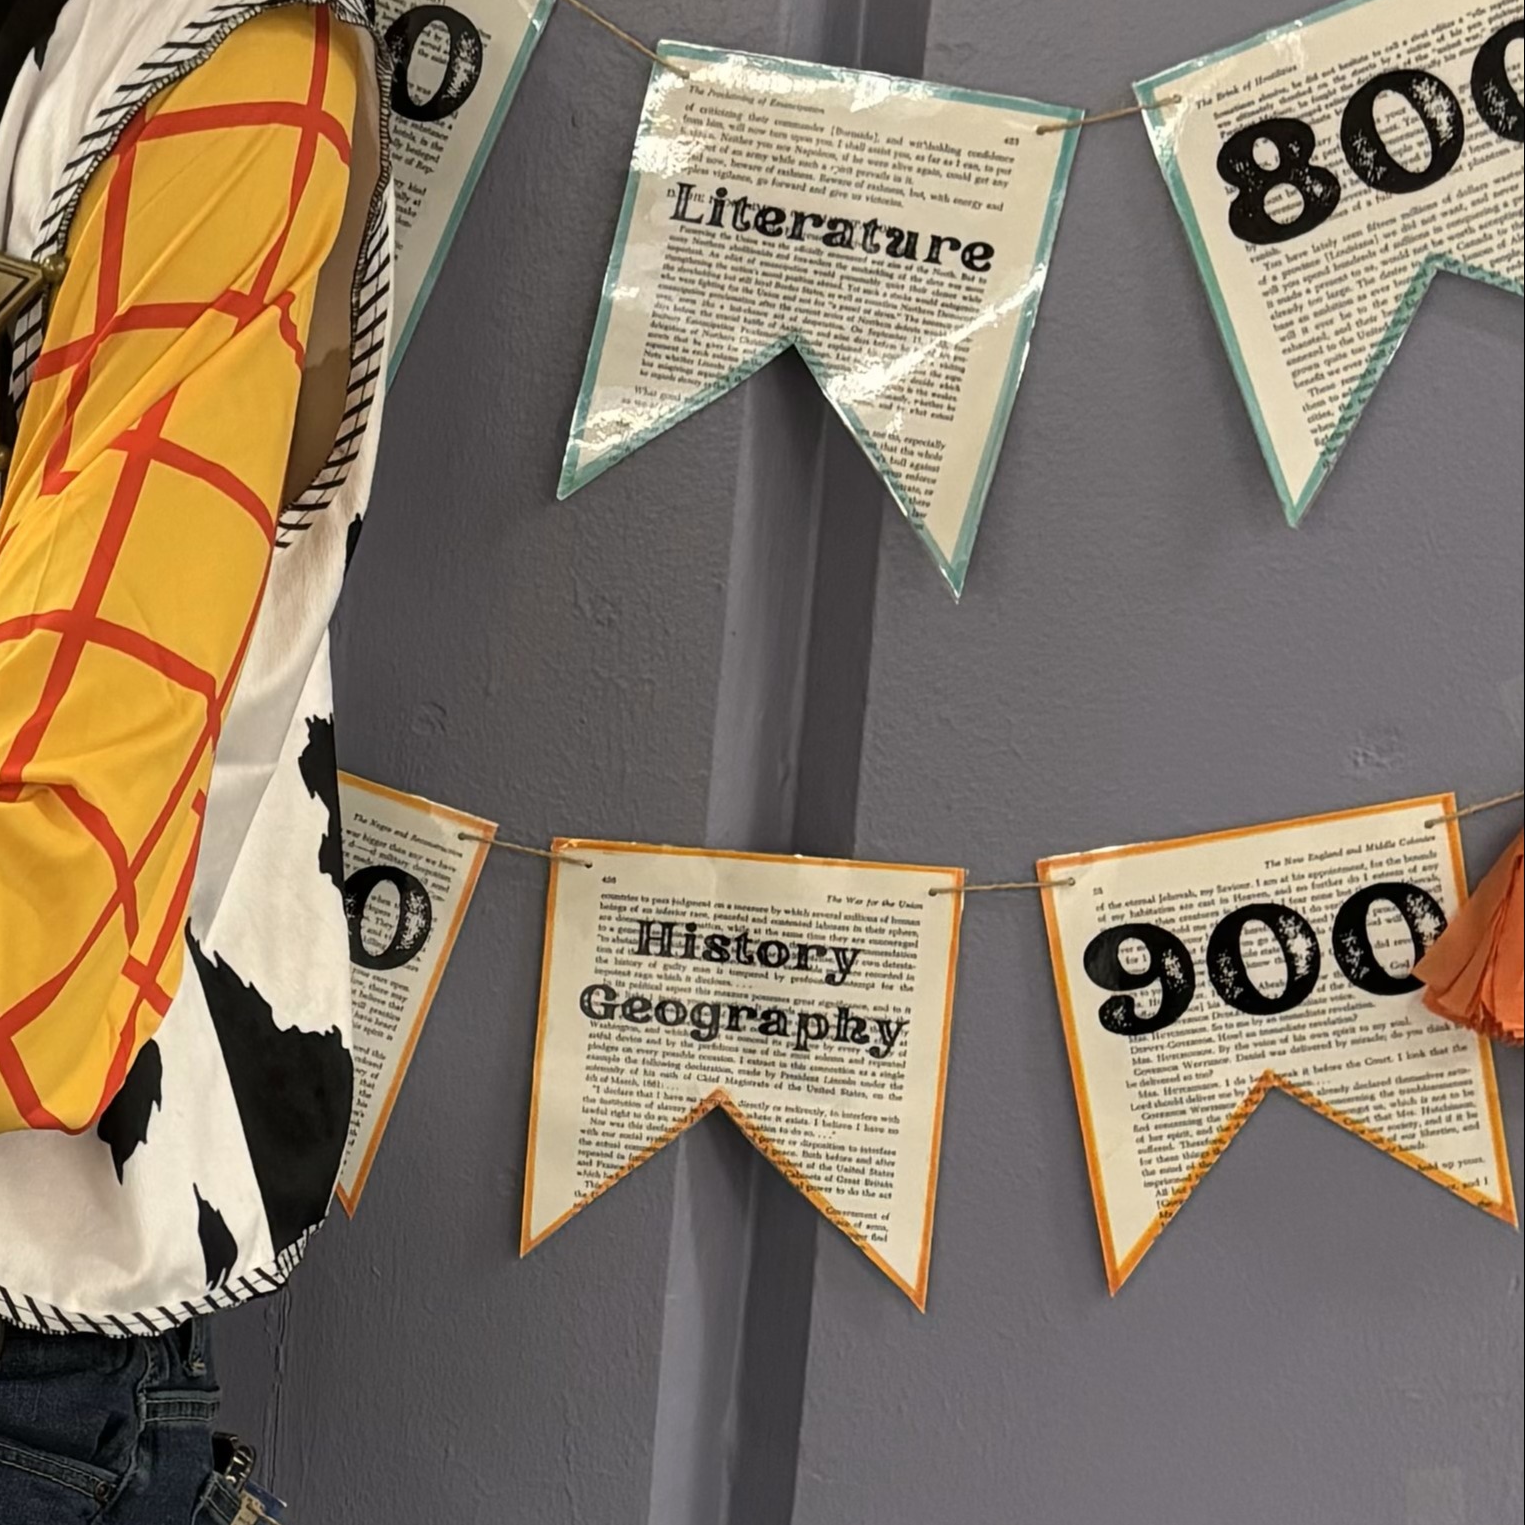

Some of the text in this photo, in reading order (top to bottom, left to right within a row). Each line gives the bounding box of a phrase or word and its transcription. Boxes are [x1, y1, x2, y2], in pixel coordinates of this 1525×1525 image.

[669, 182, 996, 273] Literature
[633, 919, 863, 986] History
[1083, 881, 1447, 1035] 900
[580, 983, 908, 1058] Geography
